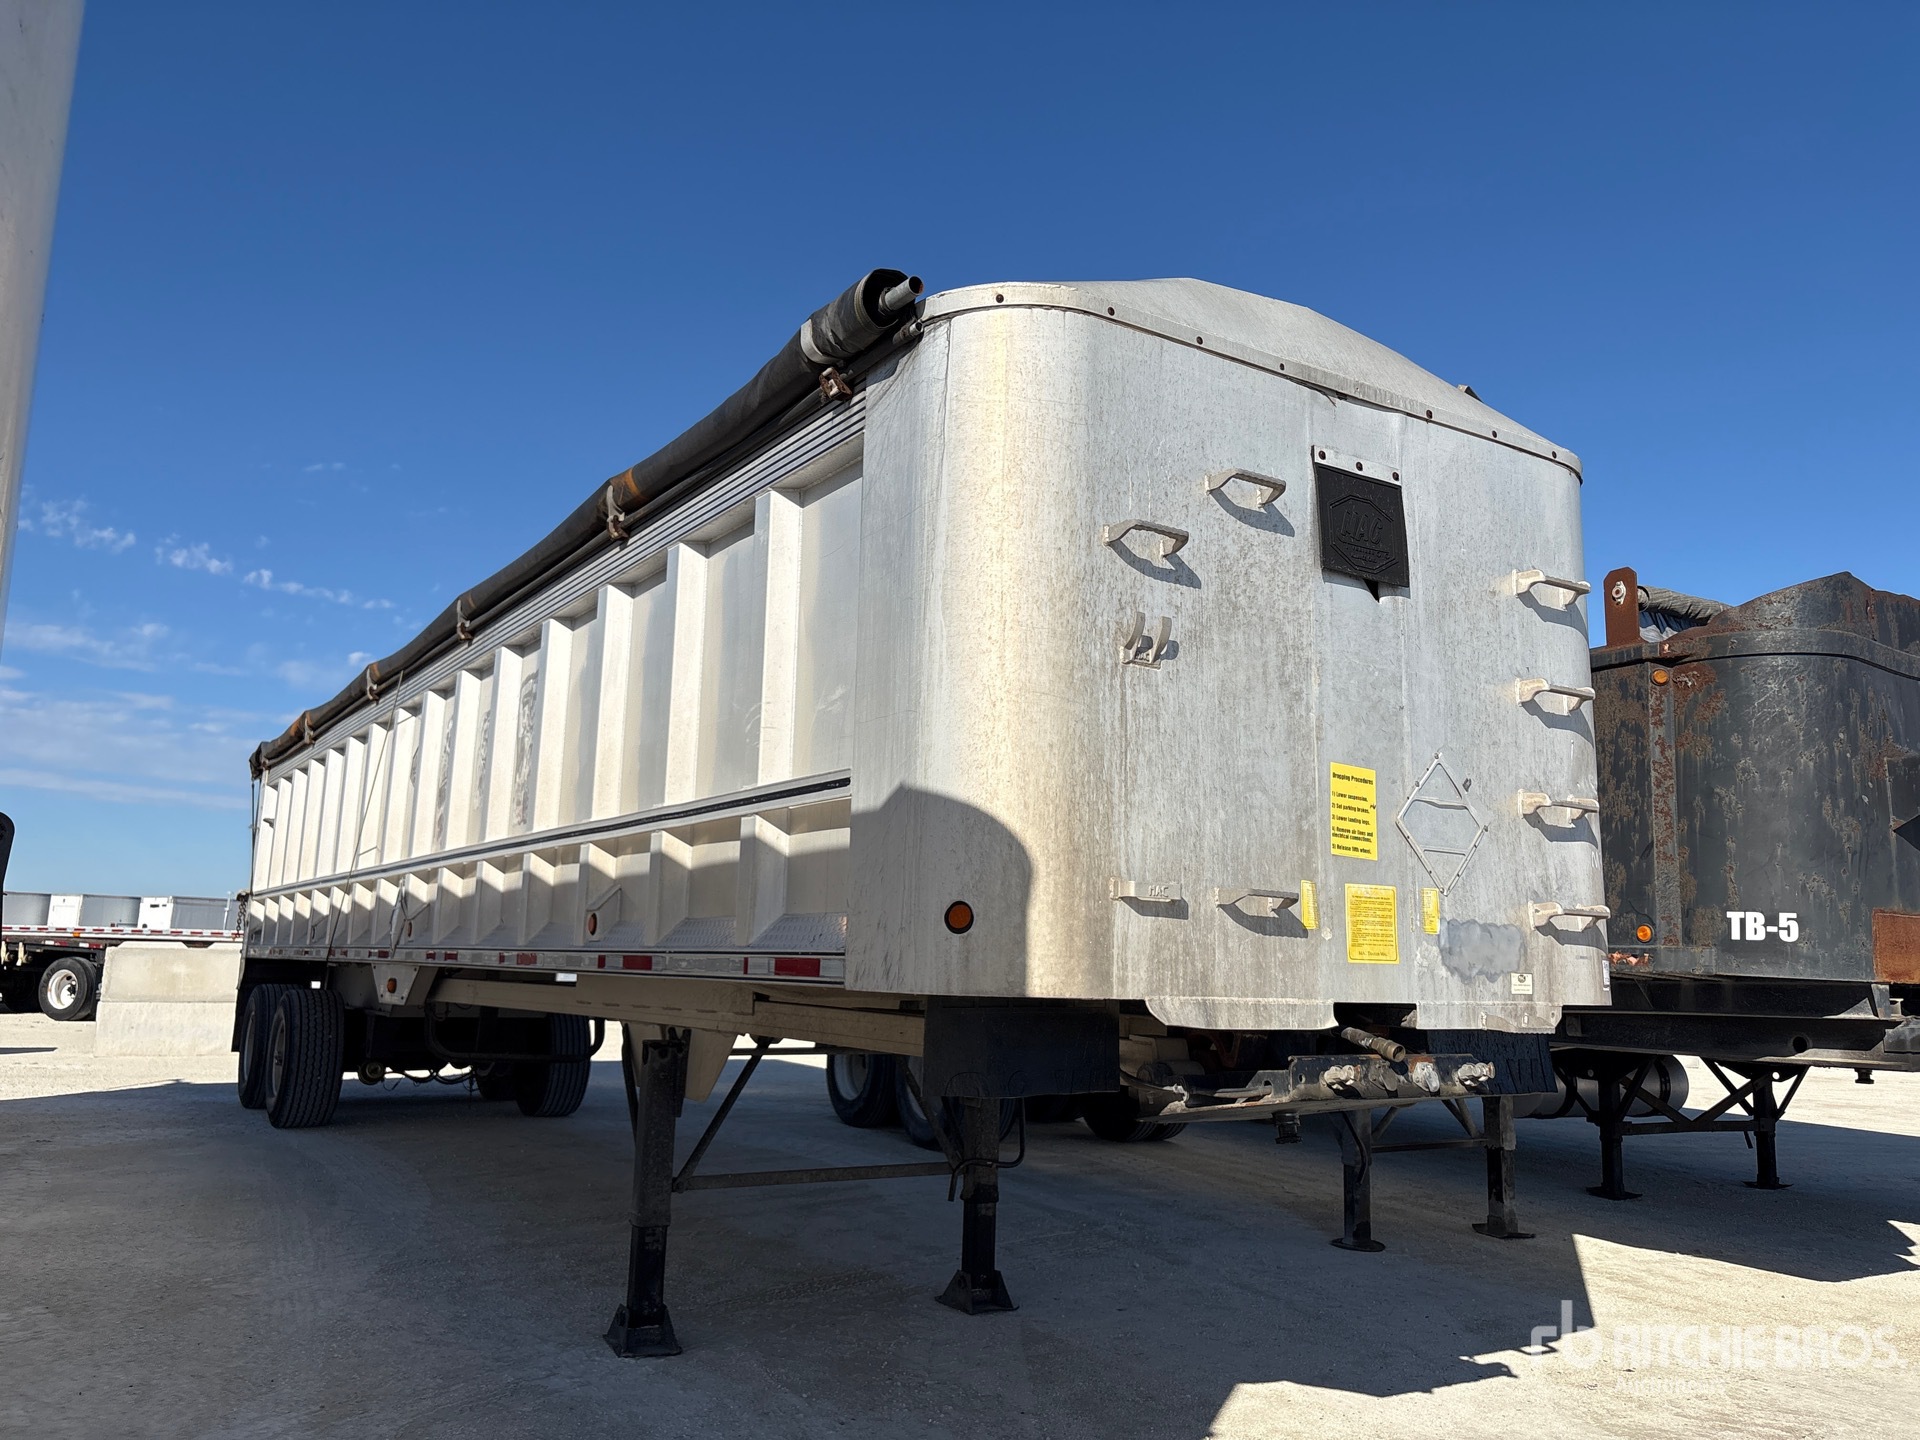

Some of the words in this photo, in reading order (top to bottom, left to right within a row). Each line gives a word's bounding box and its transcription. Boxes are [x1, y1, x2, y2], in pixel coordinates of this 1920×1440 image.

[1332, 772, 1350, 781] Dropping
[1351, 776, 1373, 785] Procedures
[1726, 911, 1799, 942] TB-5
